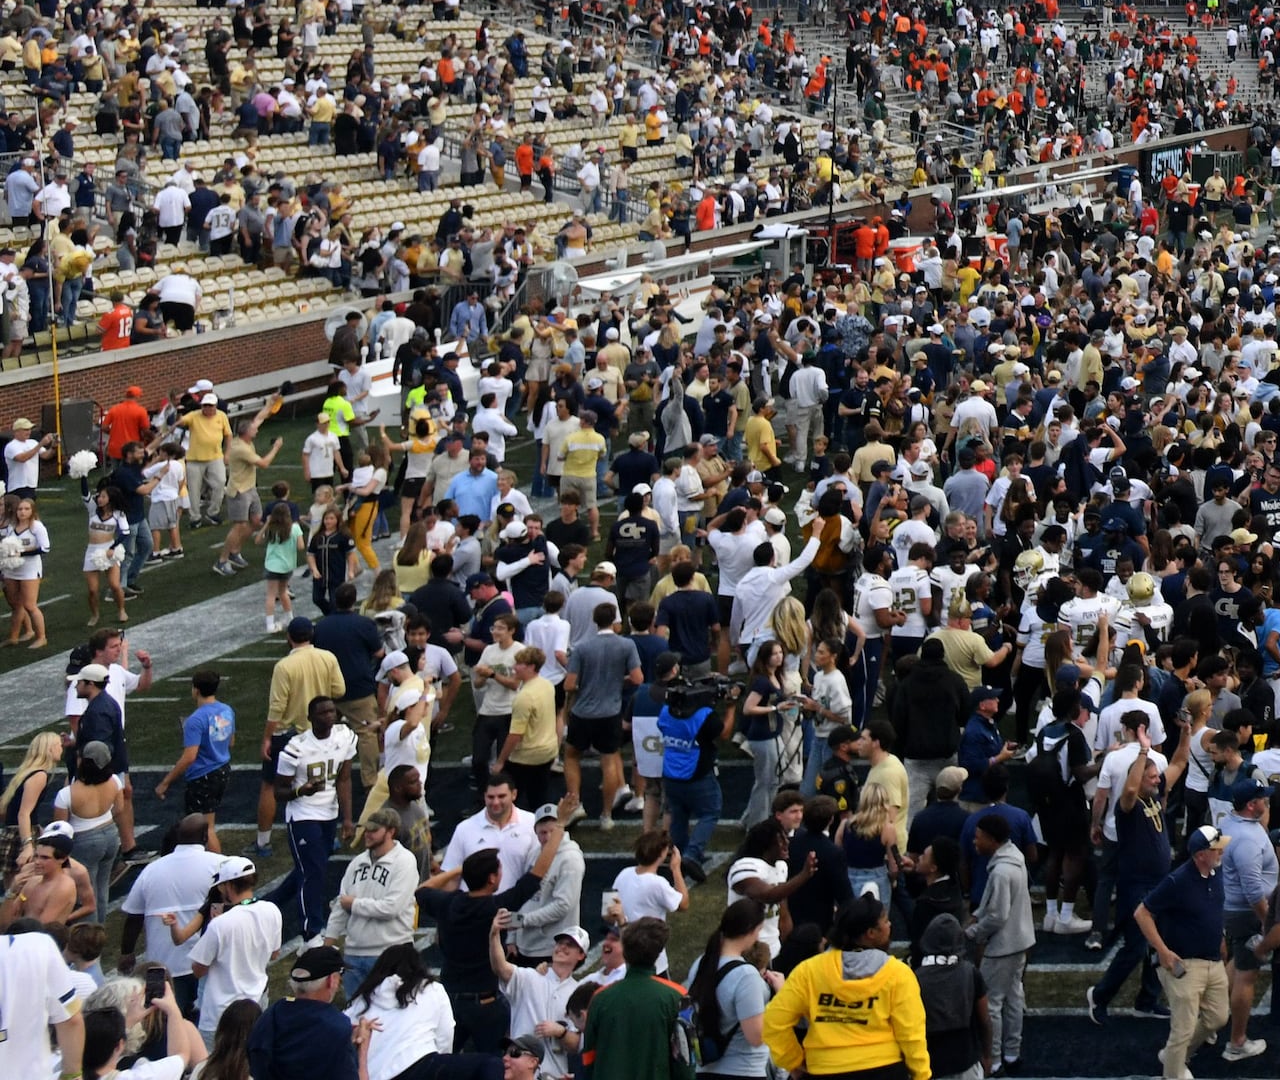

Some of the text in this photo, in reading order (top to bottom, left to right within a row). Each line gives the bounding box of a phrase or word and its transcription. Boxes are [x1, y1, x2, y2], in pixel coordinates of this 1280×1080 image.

[215, 213, 230, 228] 13
[352, 862, 390, 887] TECH
[818, 993, 879, 1011] BEST
